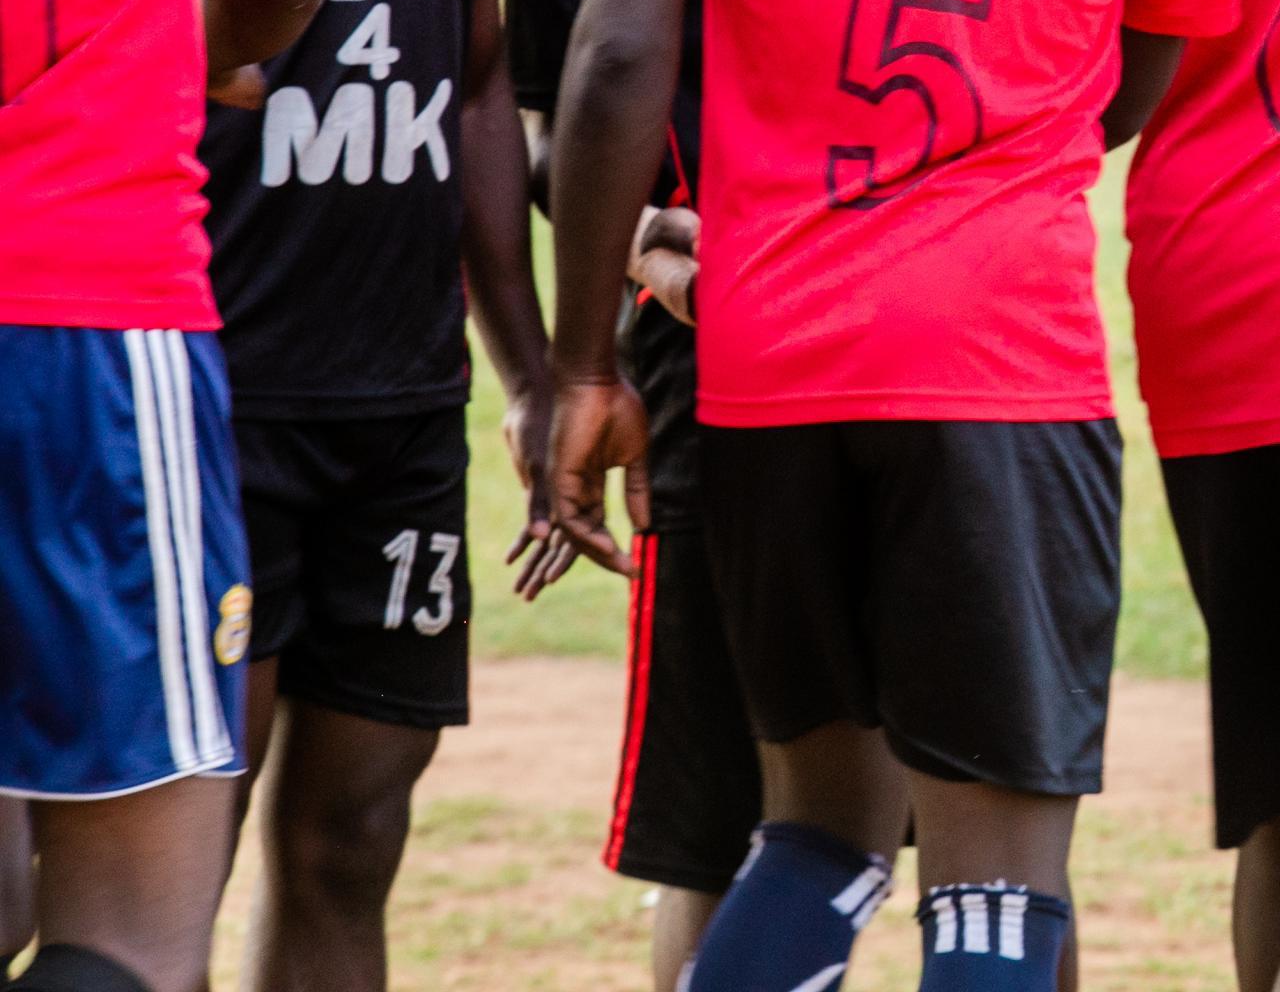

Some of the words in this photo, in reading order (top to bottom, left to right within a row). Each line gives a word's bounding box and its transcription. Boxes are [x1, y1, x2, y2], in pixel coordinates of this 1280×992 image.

[336, 2, 401, 81] 4
[261, 78, 453, 188] MK
[382, 529, 461, 636] 13
